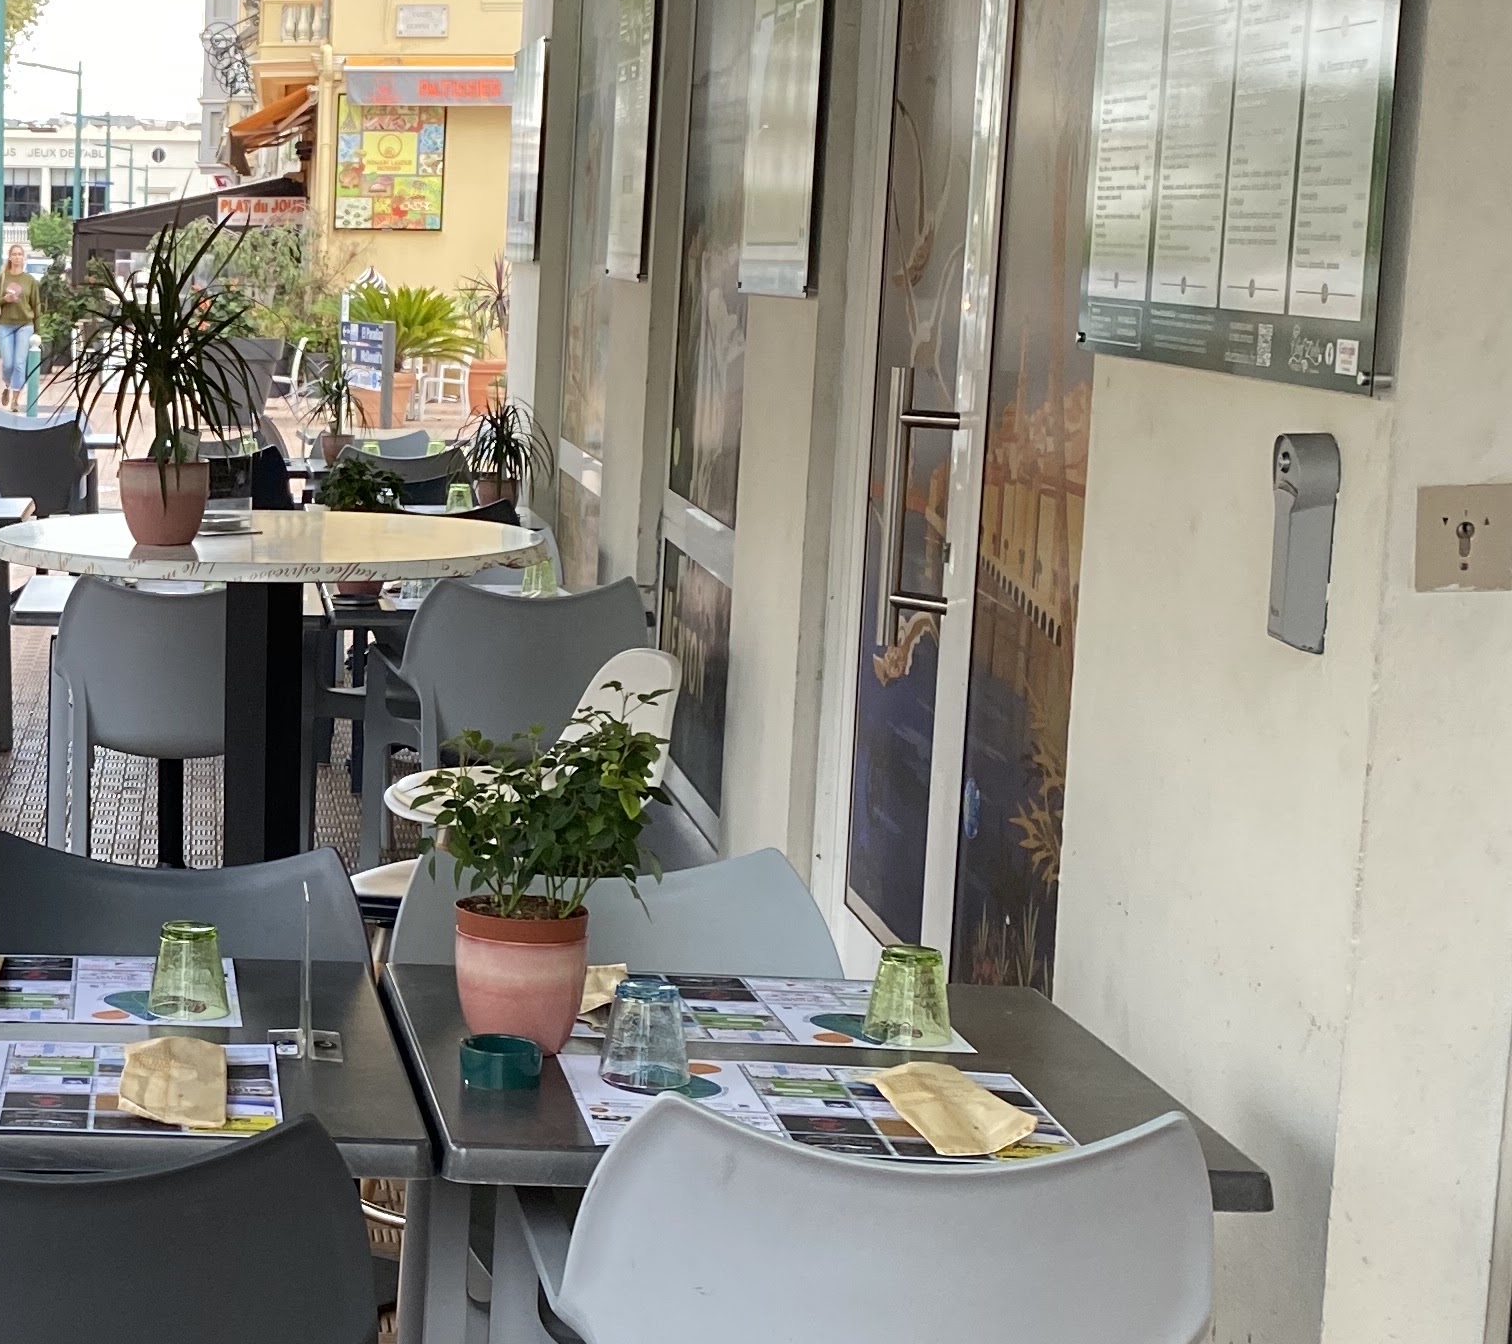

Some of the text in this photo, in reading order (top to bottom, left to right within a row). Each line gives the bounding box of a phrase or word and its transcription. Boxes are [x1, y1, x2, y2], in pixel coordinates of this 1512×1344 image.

[27, 148, 57, 158] JEUX
[60, 149, 74, 158] DE
[220, 199, 251, 213] PLAT
[253, 199, 268, 213] du
